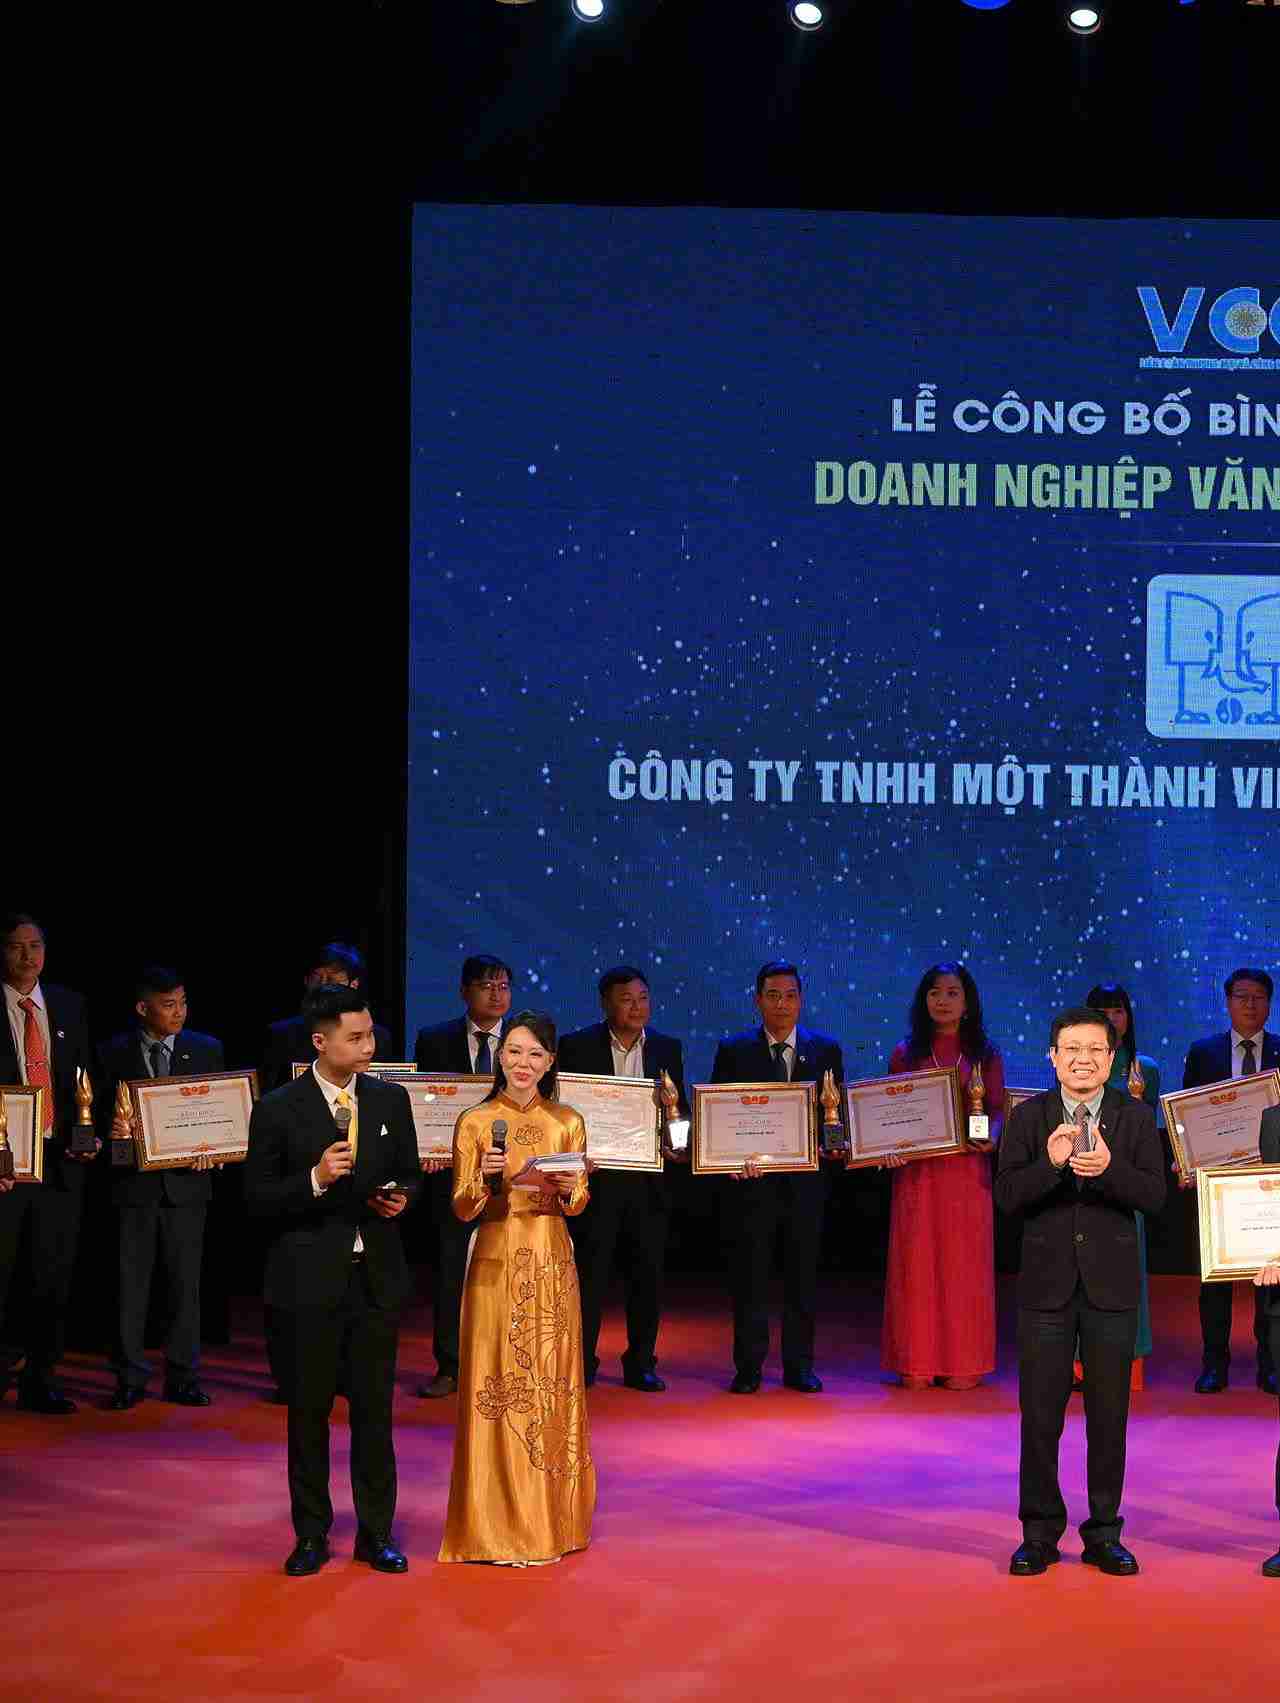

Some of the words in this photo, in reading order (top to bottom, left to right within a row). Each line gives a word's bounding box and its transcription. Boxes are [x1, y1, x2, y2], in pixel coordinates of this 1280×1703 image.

[892, 384, 935, 431] LỄ
[953, 391, 1105, 434] CÔNG
[1125, 388, 1191, 435] BỐ
[816, 461, 976, 506] DOANH
[995, 456, 1171, 518] NGHIỆP
[609, 750, 732, 803] CÔNG
[749, 761, 799, 801] TY
[816, 762, 935, 803] TNHH
[953, 755, 1050, 814] MỘT
[1065, 757, 1215, 807] THÀNH
